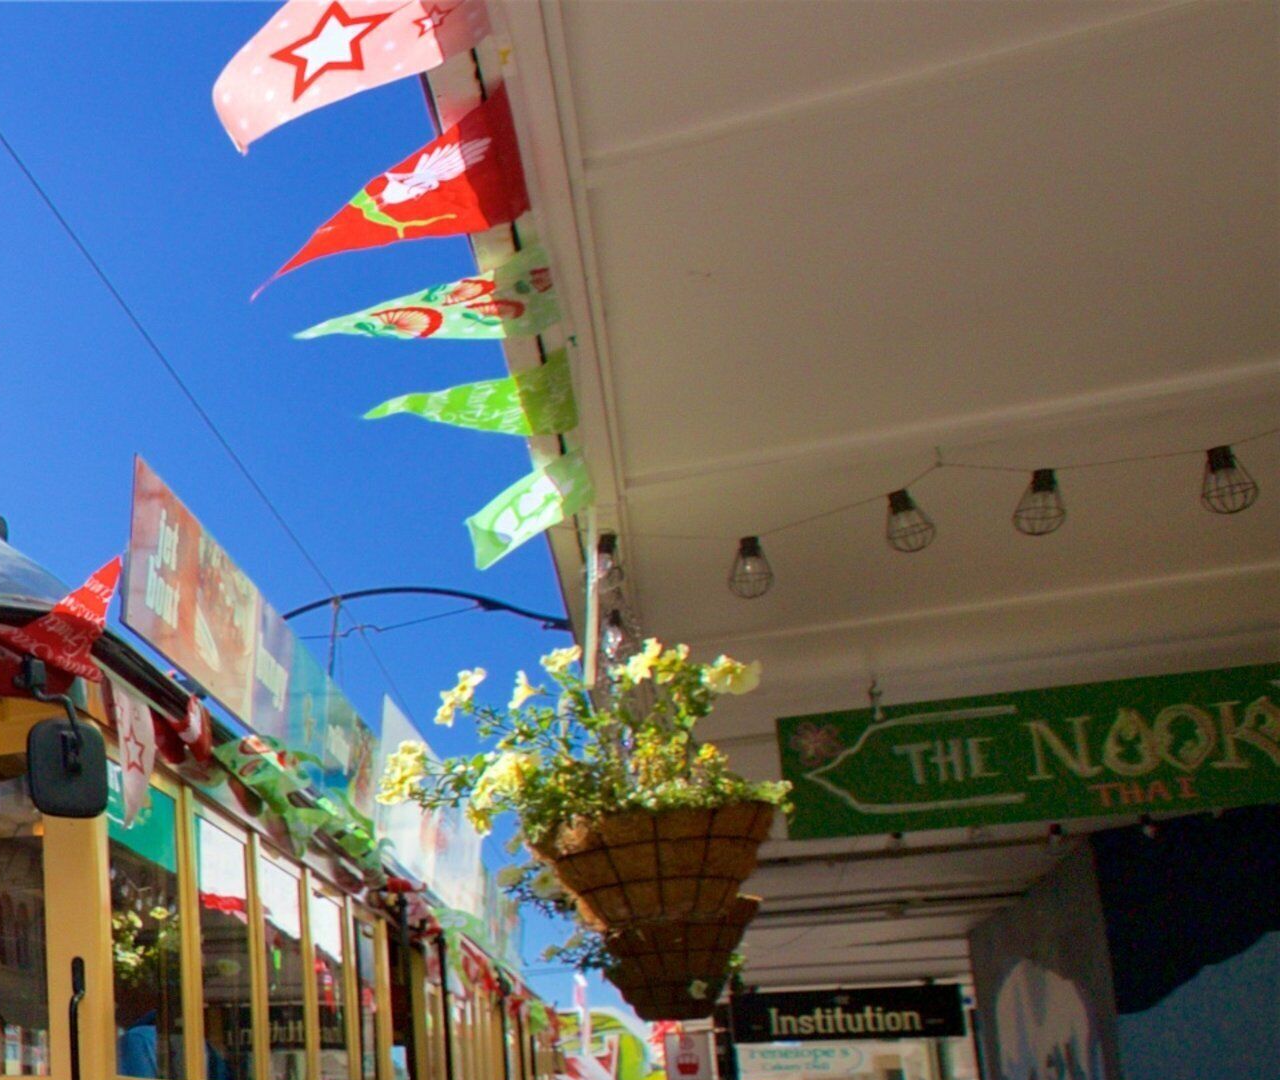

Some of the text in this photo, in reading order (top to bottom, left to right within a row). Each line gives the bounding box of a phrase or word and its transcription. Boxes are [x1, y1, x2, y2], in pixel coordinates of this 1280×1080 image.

[892, 737, 999, 785] THE
[1088, 777, 1198, 807] THAI
[768, 1006, 922, 1036] Institution
